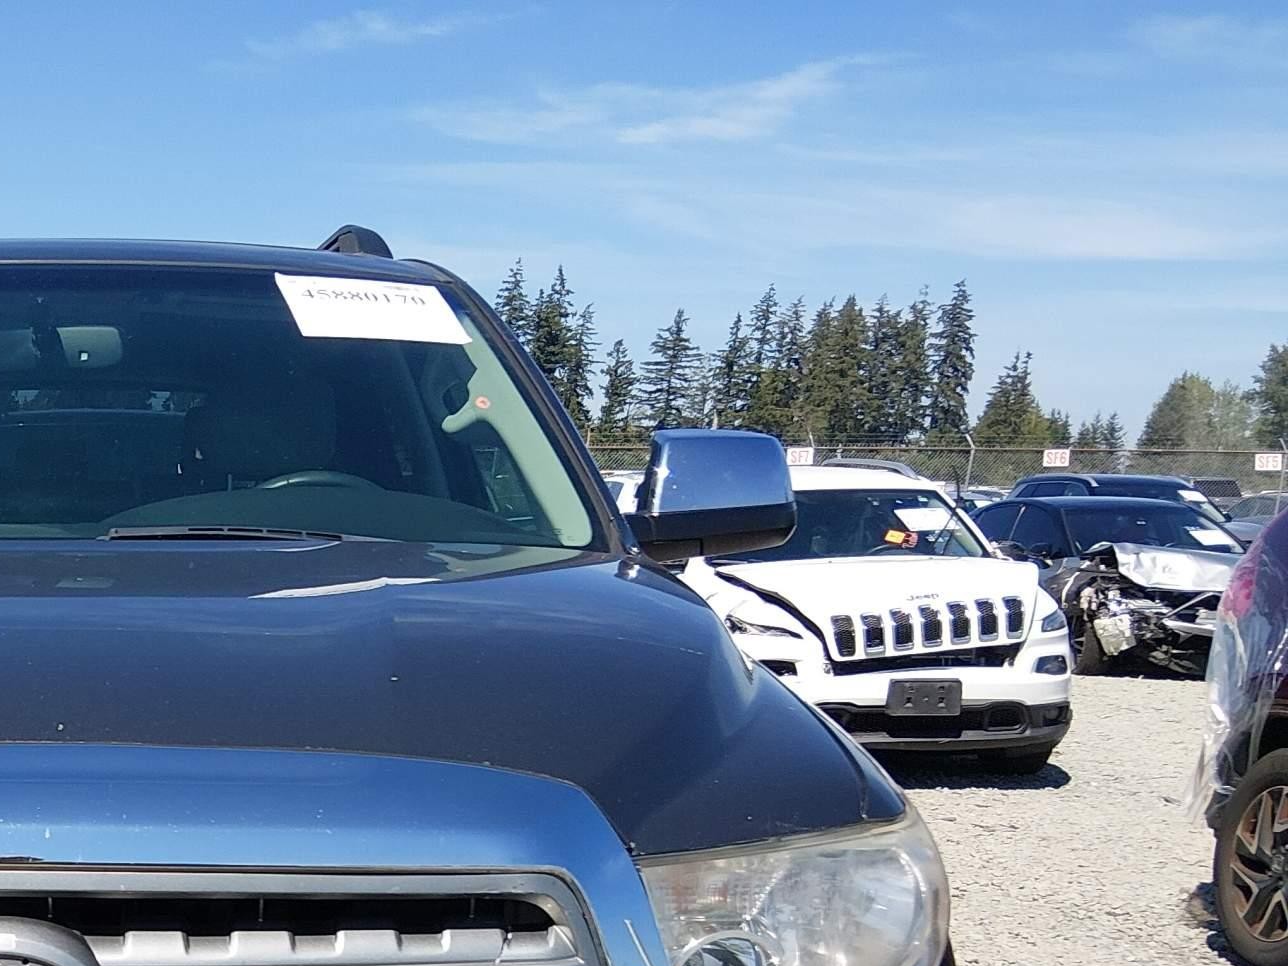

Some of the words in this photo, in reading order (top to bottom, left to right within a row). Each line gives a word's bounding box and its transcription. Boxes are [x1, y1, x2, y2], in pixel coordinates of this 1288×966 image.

[301, 288, 427, 306] 45880170
[790, 450, 809, 464] SF7
[1046, 451, 1068, 465] SF6
[1257, 455, 1280, 469] SF5
